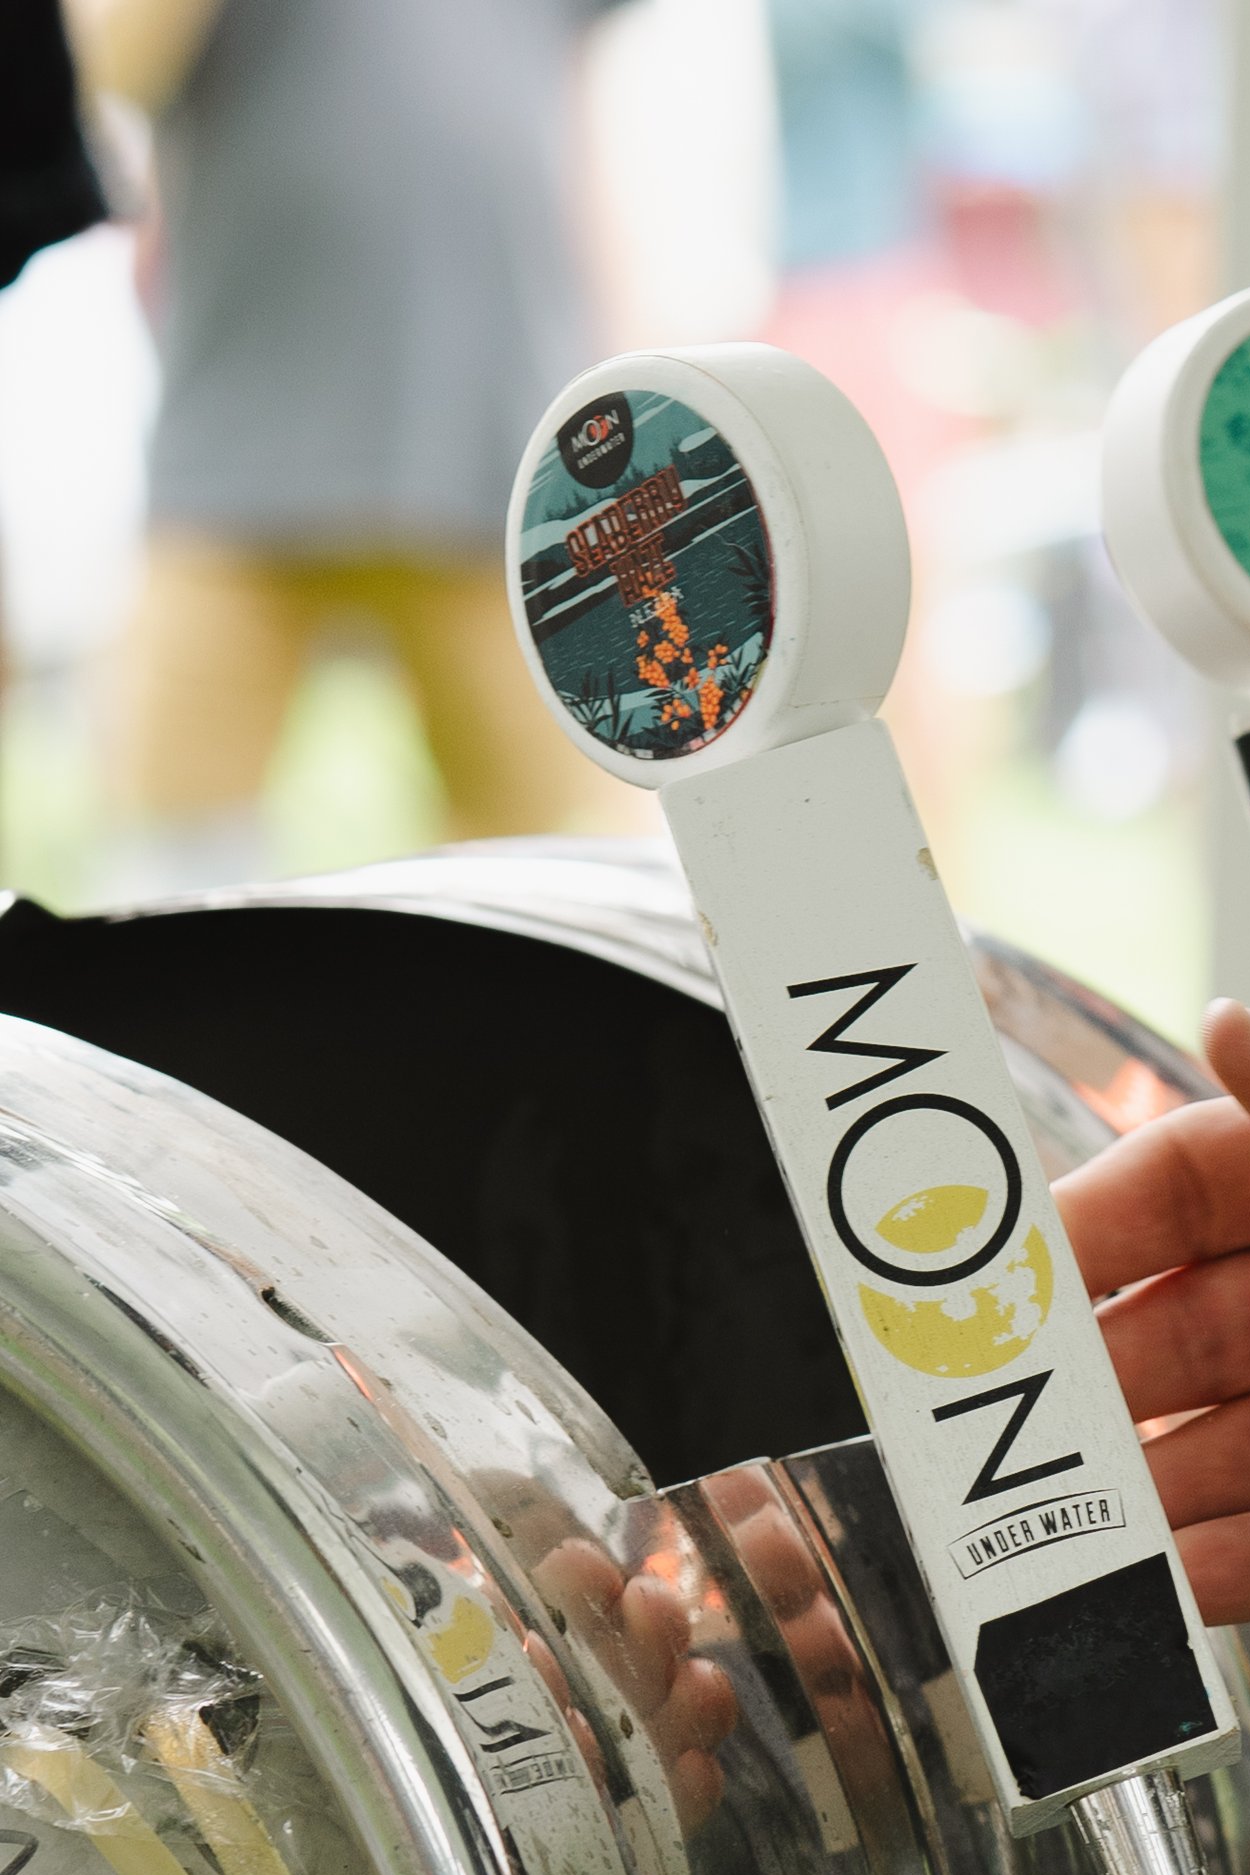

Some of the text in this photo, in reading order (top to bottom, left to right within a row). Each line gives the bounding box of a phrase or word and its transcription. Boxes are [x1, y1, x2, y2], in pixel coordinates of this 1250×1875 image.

[571, 409, 619, 452] MOON
[786, 962, 1085, 1506] MOON
[966, 1499, 1111, 1566] UNDER WATER
